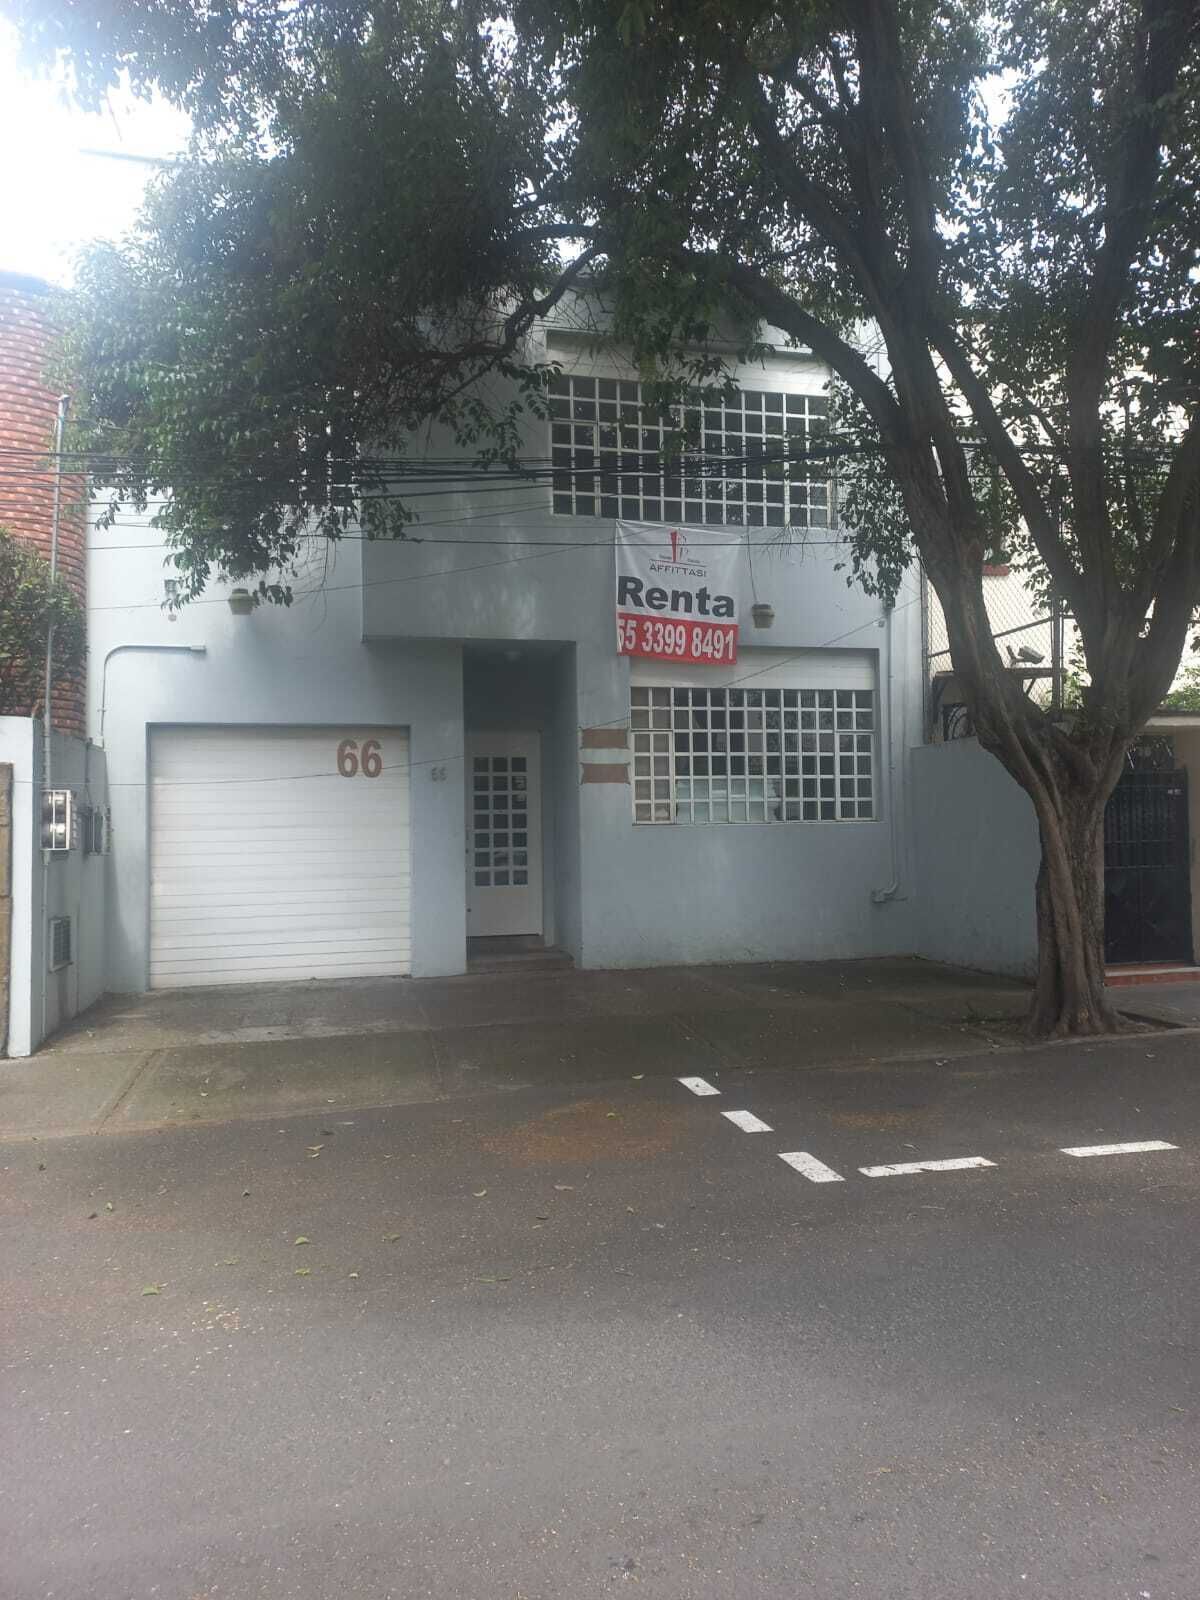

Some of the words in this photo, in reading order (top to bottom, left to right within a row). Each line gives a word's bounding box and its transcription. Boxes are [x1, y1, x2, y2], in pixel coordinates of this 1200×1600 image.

[649, 563, 707, 578] AFFITTASI
[617, 575, 735, 618] Renta
[641, 621, 686, 655] 3399
[691, 627, 735, 660] 8491
[337, 740, 382, 778] 66
